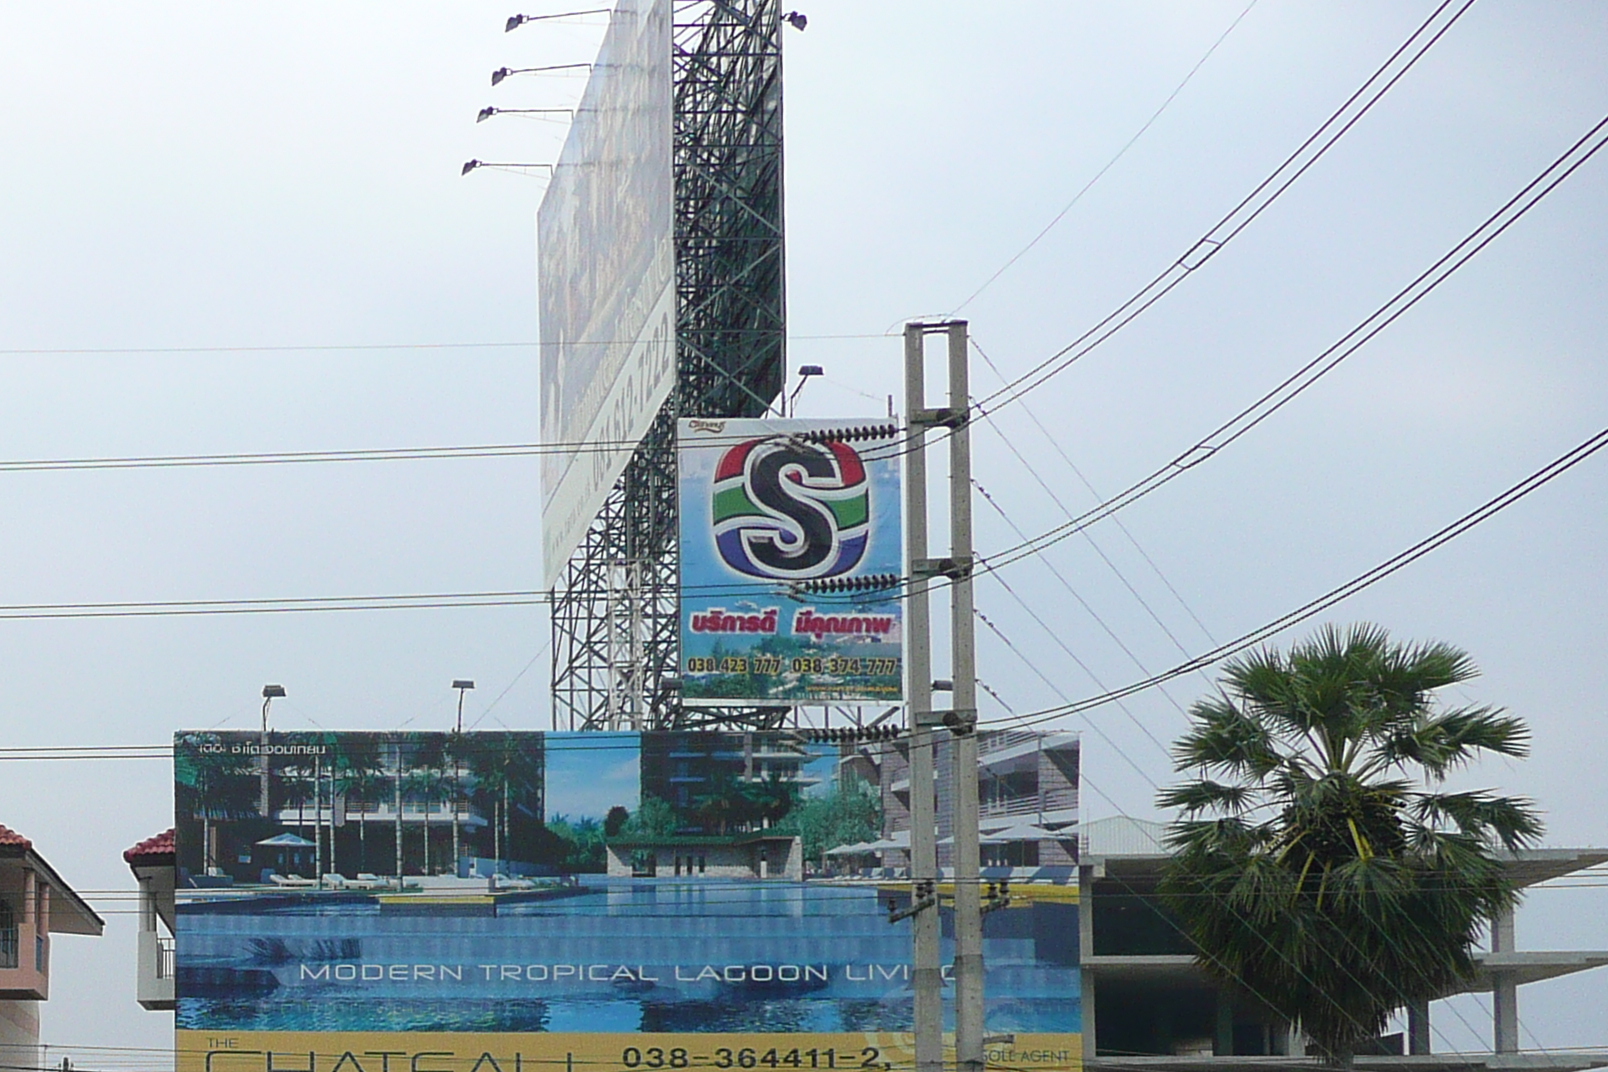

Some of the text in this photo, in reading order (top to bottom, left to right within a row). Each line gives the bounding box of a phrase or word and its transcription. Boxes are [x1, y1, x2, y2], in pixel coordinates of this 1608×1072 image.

[691, 608, 893, 639] บริการดี มีคุณภาพ
[688, 657, 897, 675] 038 423 777 038 374 777
[300, 964, 462, 981] MODERN
[479, 964, 660, 982] TROPICAL
[674, 964, 827, 983] LAGOON
[208, 1037, 238, 1048] THE
[622, 1046, 893, 1071] 038-364411-2,
